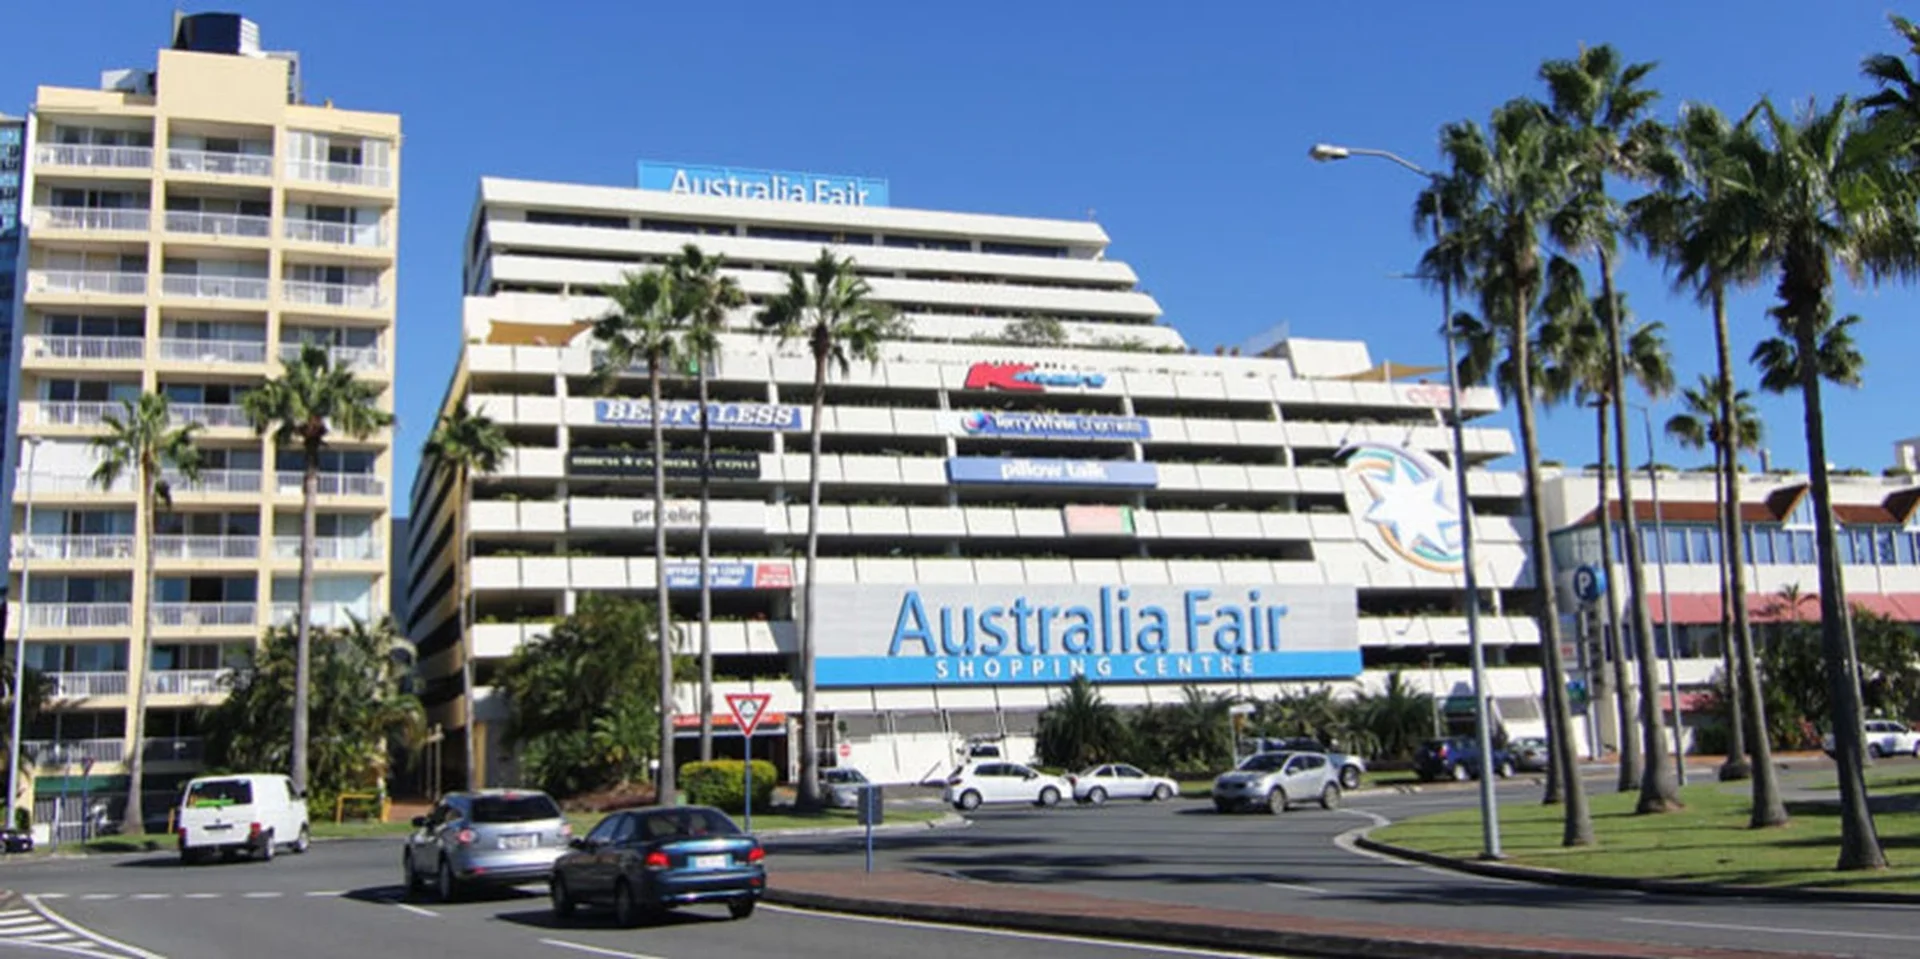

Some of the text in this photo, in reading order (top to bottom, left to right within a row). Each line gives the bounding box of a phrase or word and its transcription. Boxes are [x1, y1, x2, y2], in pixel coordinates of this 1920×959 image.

[671, 169, 870, 207] Australia Fair
[716, 403, 791, 425] LESS
[635, 457, 697, 469] CAROLL
[1001, 461, 1109, 480] pillow talk
[632, 505, 710, 526] prelin
[1577, 570, 1592, 596] P
[888, 586, 1289, 657] Australia Fair
[936, 655, 1257, 679] SHOPPING CENTRE
